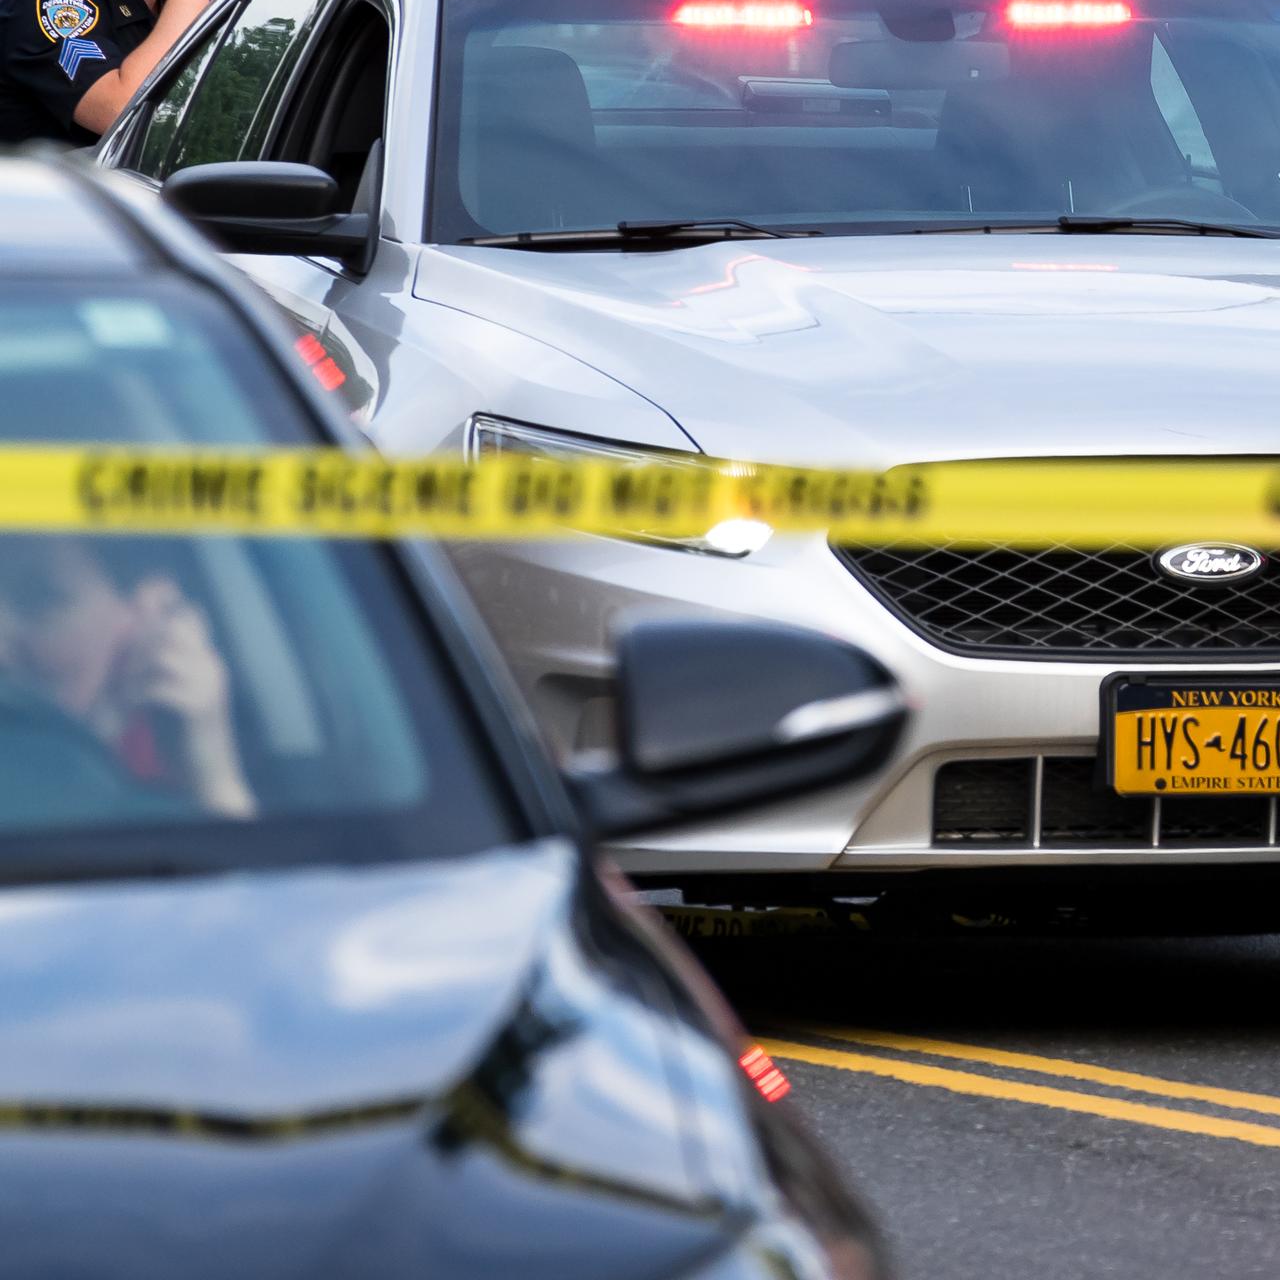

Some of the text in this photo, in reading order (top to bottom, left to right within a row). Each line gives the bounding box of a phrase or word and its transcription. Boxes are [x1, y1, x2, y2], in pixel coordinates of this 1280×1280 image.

[1181, 548, 1243, 574] Ford
[1172, 690, 1224, 708] NEW
[1171, 775, 1230, 790] EMPIRE
